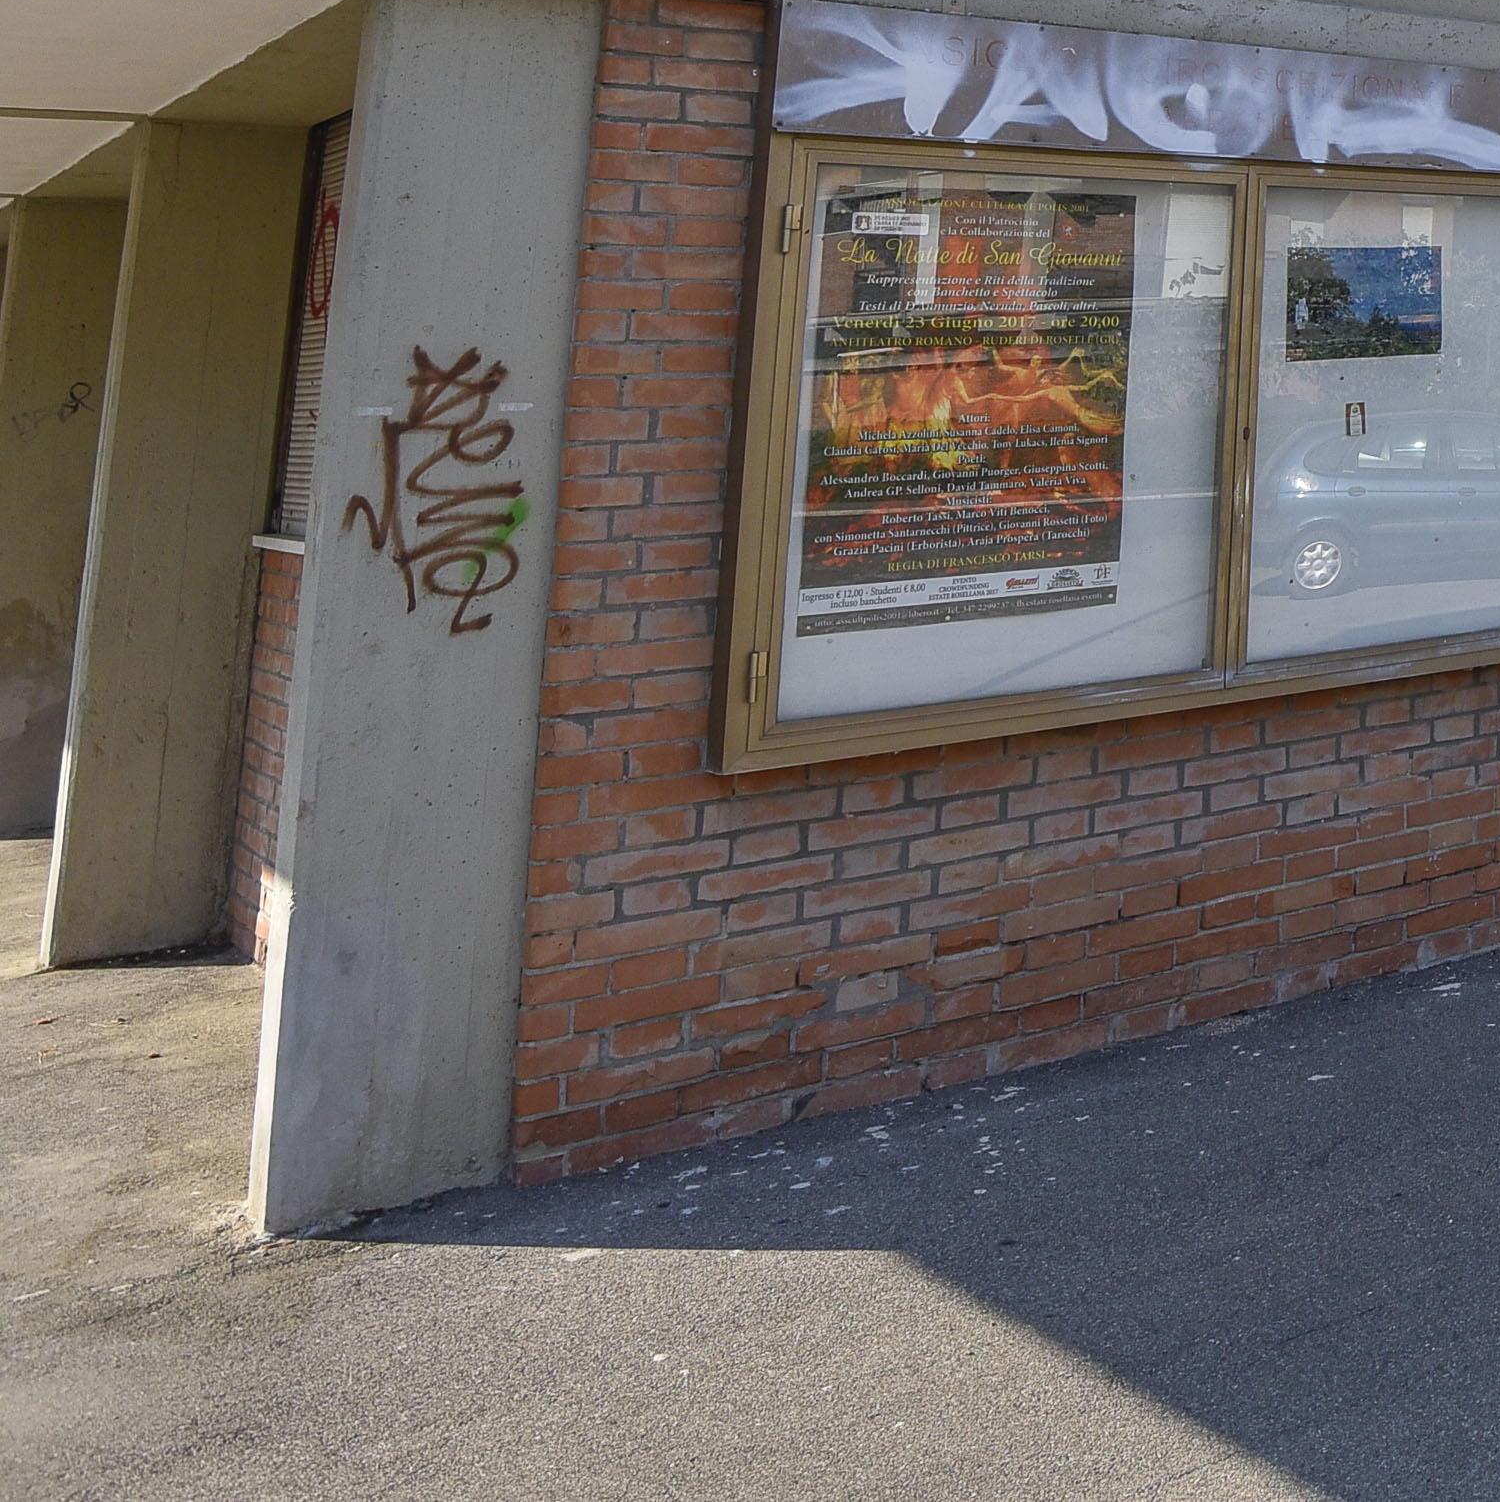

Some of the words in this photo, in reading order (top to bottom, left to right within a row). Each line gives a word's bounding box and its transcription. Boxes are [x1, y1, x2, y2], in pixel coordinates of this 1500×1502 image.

[955, 216, 976, 224] Con
[987, 216, 1039, 226] Patrocinio
[948, 226, 957, 236] la
[960, 226, 1034, 238] Collaborazione
[837, 237, 878, 264] La
[886, 237, 953, 265] Notte
[956, 241, 978, 265] di
[983, 240, 1024, 266] San
[1029, 241, 1123, 274] Giovanni
[867, 274, 972, 287] Rappresentazione
[975, 277, 982, 285] e
[984, 275, 1005, 286] Riti
[1007, 275, 1034, 286] della
[1037, 275, 1095, 286] Tradizione
[907, 288, 928, 297] con
[932, 286, 990, 298] Banchetto
[993, 289, 1000, 297] e
[1002, 287, 1058, 300] Spettacolo
[905, 316, 925, 329] 23
[931, 315, 993, 331] Giugno
[998, 315, 1036, 328] 2017
[1051, 317, 1076, 328] ore
[958, 413, 991, 423] Attori:
[858, 429, 897, 441] Michela
[943, 428, 982, 438] Susanna
[1020, 424, 1041, 435] Elisa
[958, 454, 986, 465] Poeti:
[820, 473, 879, 486] Alessandro
[882, 469, 930, 482] Boccardi,
[933, 468, 979, 480] Giovanni
[1023, 461, 1076, 475] Giuseppina
[845, 487, 884, 499] Andrea
[906, 484, 944, 495] Selloni,
[946, 481, 976, 492] David
[978, 479, 1027, 491] Tammaro,
[1030, 476, 1062, 487] Valeria
[1065, 475, 1086, 485] Viva
[945, 496, 992, 507] Musicisti:
[881, 513, 923, 524] Roberto
[955, 509, 990, 520] Marco
[990, 507, 1007, 517] Viti
[1010, 504, 1050, 516] Benocci,
[814, 535, 832, 544] con
[835, 529, 886, 543] Simonetta
[888, 524, 950, 538] Santarnecchi
[999, 518, 1041, 530] Giovanni
[1043, 515, 1079, 527] Rossetti
[1081, 514, 1108, 525] (Foto)
[833, 546, 869, 556] Grazia
[872, 542, 904, 554] Pacini
[967, 535, 994, 547] Araja
[996, 532, 1039, 545] Prospera
[1041, 527, 1090, 541] (Tarocchi)
[888, 560, 923, 573] REGIA
[927, 559, 941, 570] DI
[943, 553, 1011, 569] FRANCESCO
[1014, 550, 1045, 562] TARSI
[801, 591, 835, 603] Ingresso
[870, 585, 901, 596] Studenti
[910, 583, 926, 593] 8,00
[830, 599, 858, 609] incluso
[860, 595, 897, 607] banchetto
